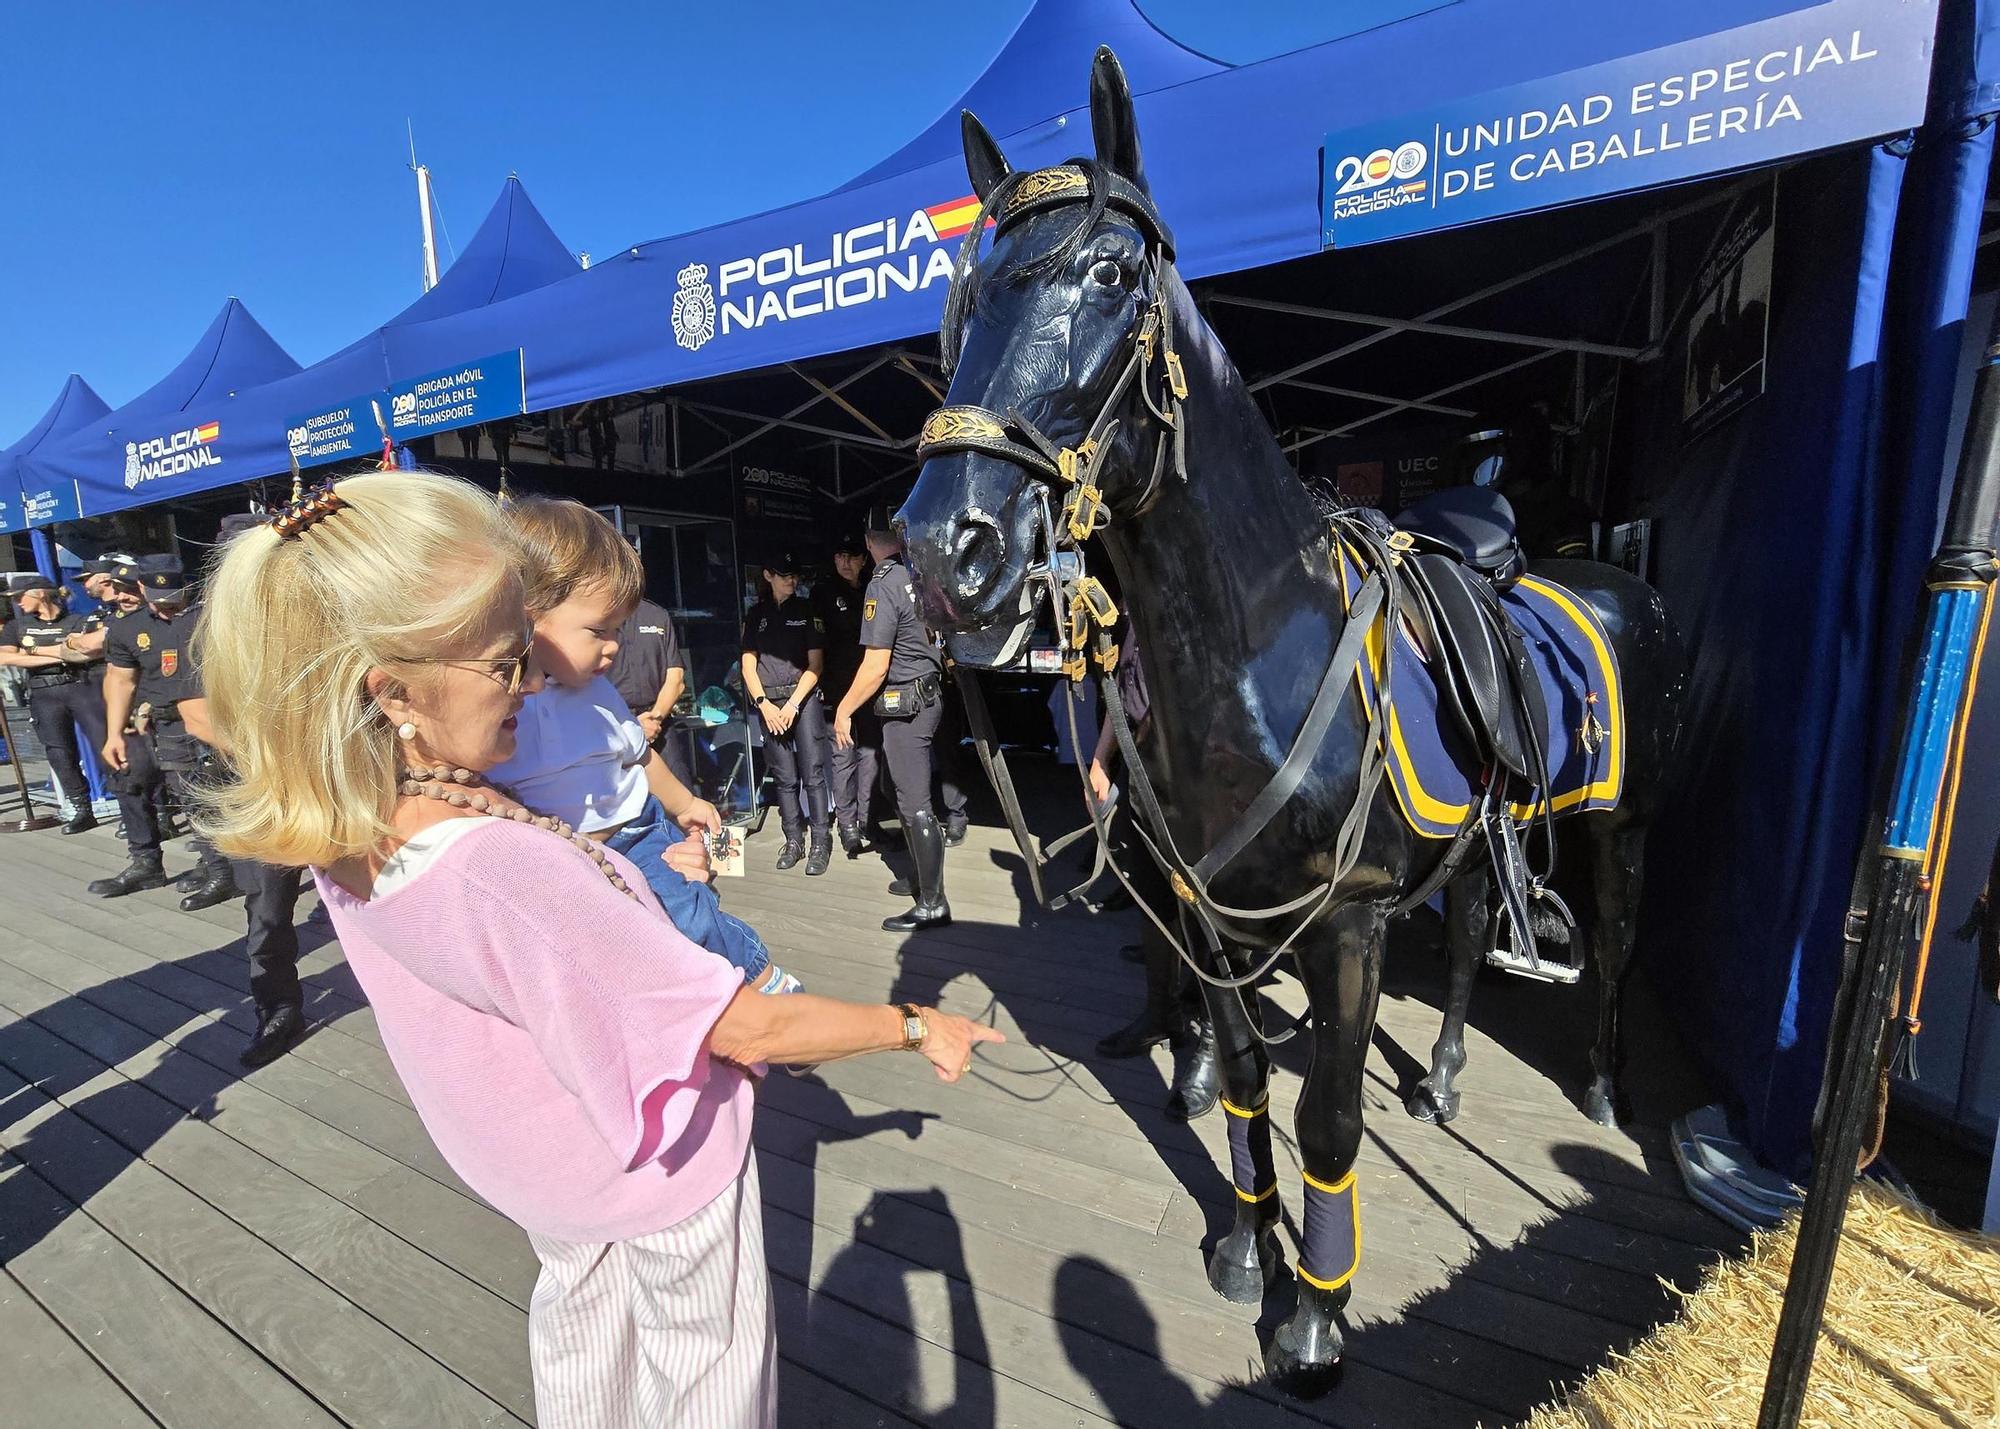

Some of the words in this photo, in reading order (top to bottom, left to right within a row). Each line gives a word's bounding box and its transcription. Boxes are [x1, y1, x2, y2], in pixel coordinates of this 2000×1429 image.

[1444, 94, 1614, 157] UNIDAD
[1630, 29, 1878, 115] ESPECIAL
[1442, 161, 1495, 199] DE
[1509, 91, 1803, 182] CABALLERÍA
[1335, 141, 1427, 195] 200
[1334, 192, 1425, 220] NACIONAL
[417, 377, 454, 396] BRIGADA
[455, 368, 483, 385] MÓVIL
[392, 392, 416, 416] 200
[419, 391, 451, 411] POLICÍA
[452, 389, 465, 403] EN
[466, 386, 477, 399] EL
[307, 410, 344, 429] SUBSUELO
[343, 408, 350, 419] Y
[419, 404, 474, 427] TRANSPORTE
[310, 421, 355, 443] PROTECCIÓN
[312, 438, 352, 457] AMBIENTAL
[139, 445, 222, 482] NACIONAL
[1399, 456, 1439, 473] UEC
